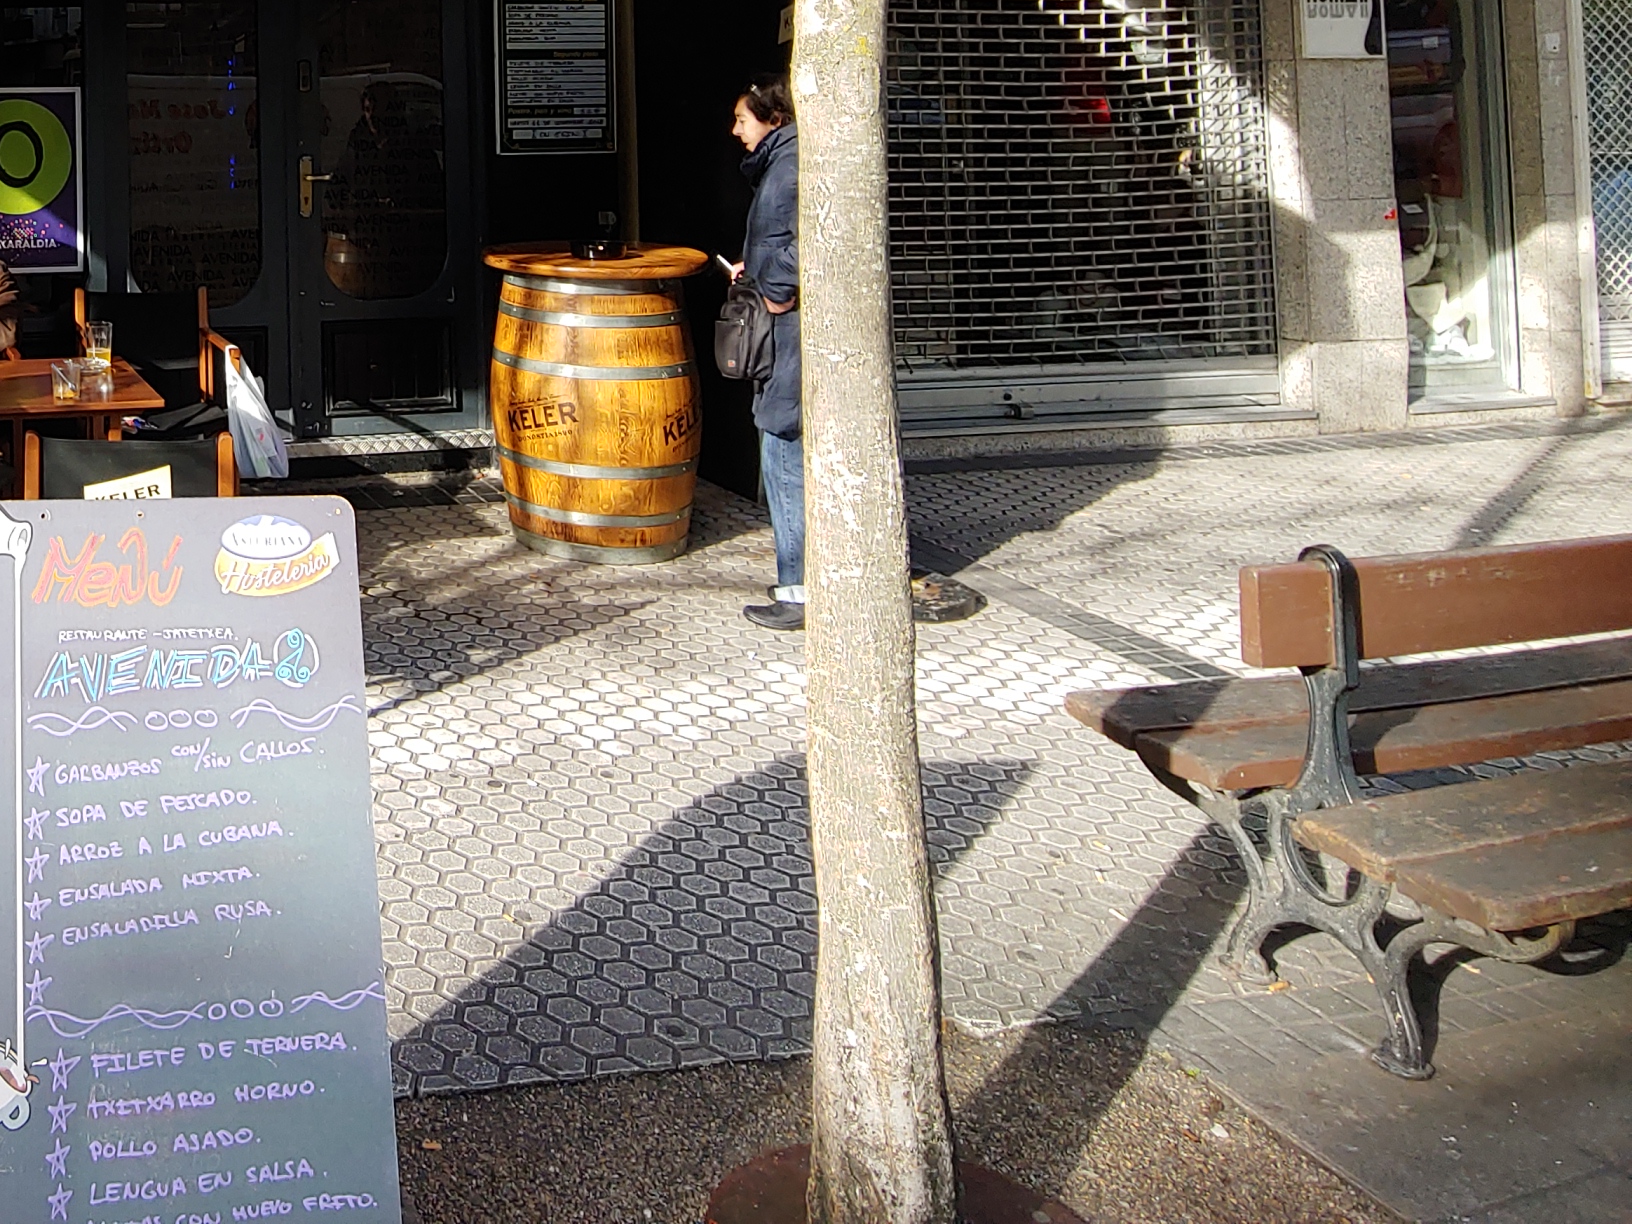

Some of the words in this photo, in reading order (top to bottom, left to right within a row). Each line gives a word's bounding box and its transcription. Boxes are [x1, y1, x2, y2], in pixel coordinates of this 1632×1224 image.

[507, 402, 579, 433] KELER
[33, 638, 273, 703] AVENIDA
[55, 759, 163, 785] GARBANZOS
[55, 805, 106, 827] SOPA
[120, 800, 148, 818] DE
[59, 842, 124, 865] ARROZ
[138, 837, 153, 856] A
[163, 832, 186, 853] LA
[59, 878, 163, 907] ENSALADA
[62, 909, 199, 946] ENSALADILLA
[91, 1047, 186, 1077] FILETE
[198, 1040, 236, 1061] DE
[89, 1140, 157, 1163] POLLO
[89, 1178, 187, 1206] LENGUA
[198, 1172, 233, 1194] EN
[233, 1200, 293, 1222] HUEVO
